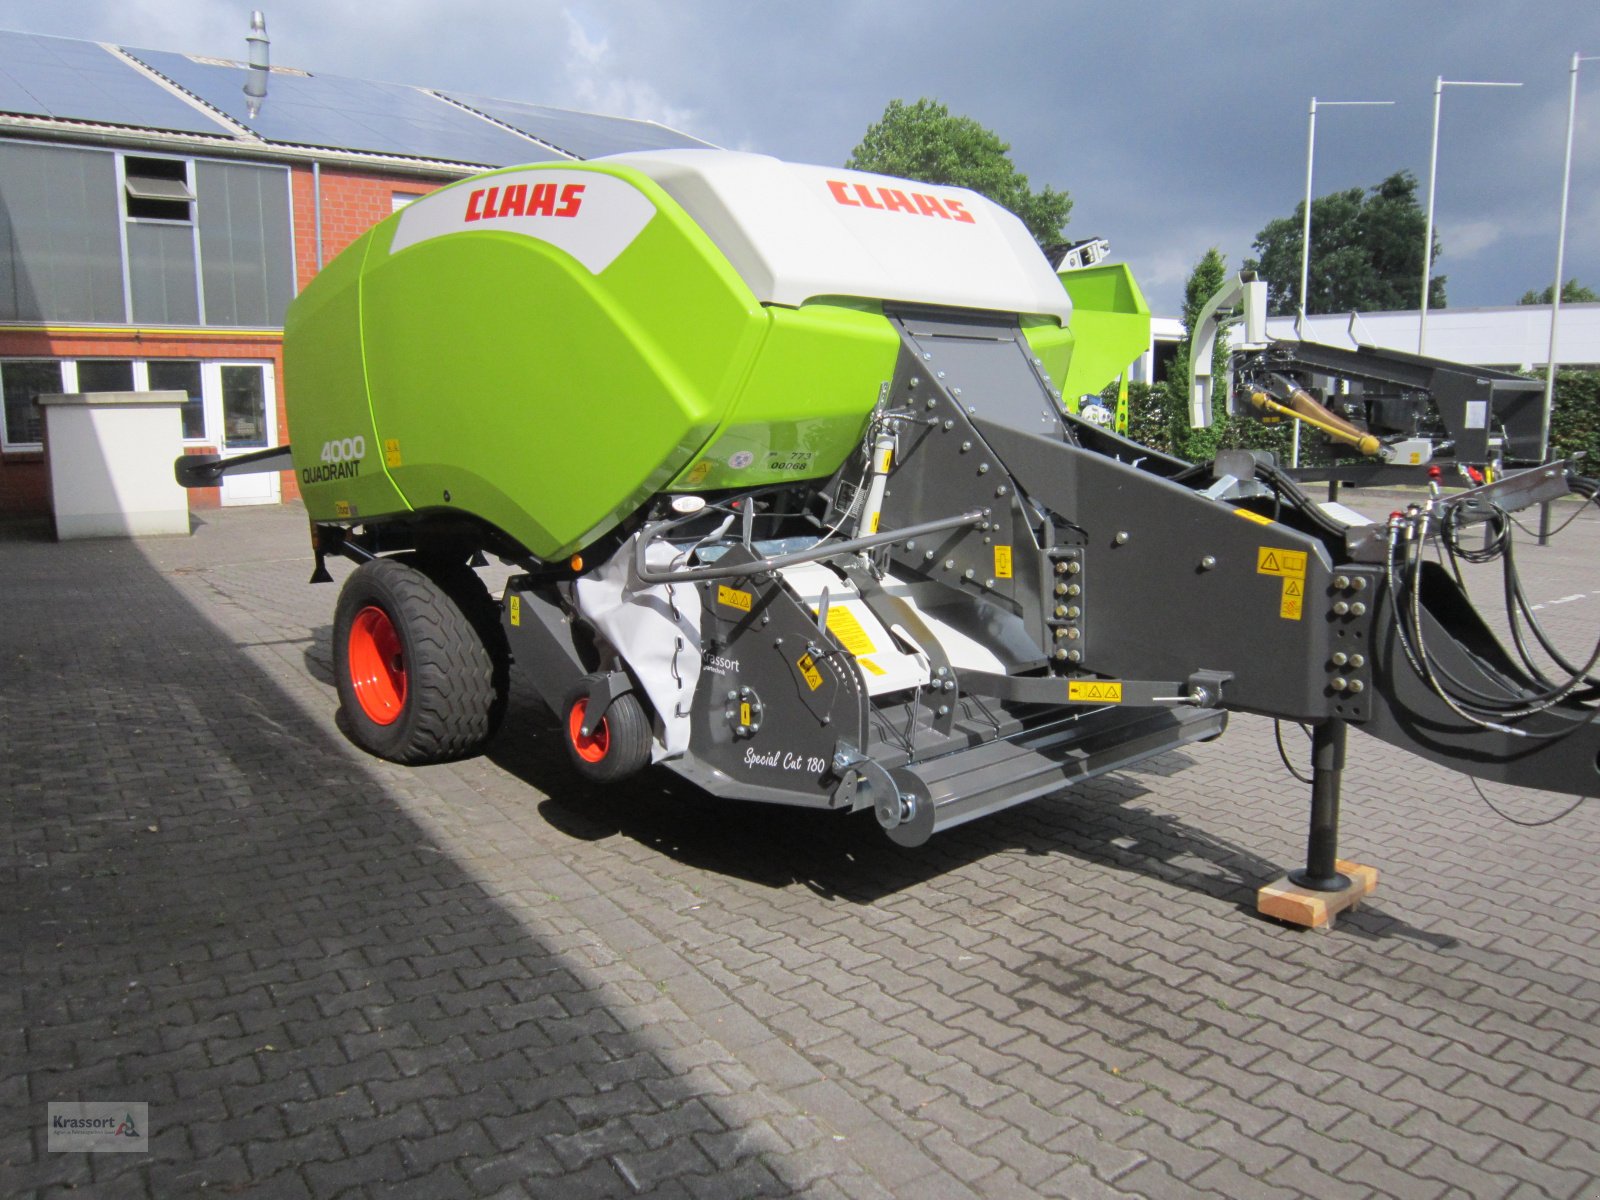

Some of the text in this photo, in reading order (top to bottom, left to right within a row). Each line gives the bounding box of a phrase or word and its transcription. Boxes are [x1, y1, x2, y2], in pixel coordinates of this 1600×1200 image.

[464, 183, 586, 222] CLAAS
[827, 180, 976, 224] CLAAS
[321, 436, 365, 463] 4000
[302, 460, 360, 484] QUADRANT
[770, 462, 807, 470] 00068
[700, 648, 740, 672] Krassort
[743, 747, 825, 773] Special Cut 180
